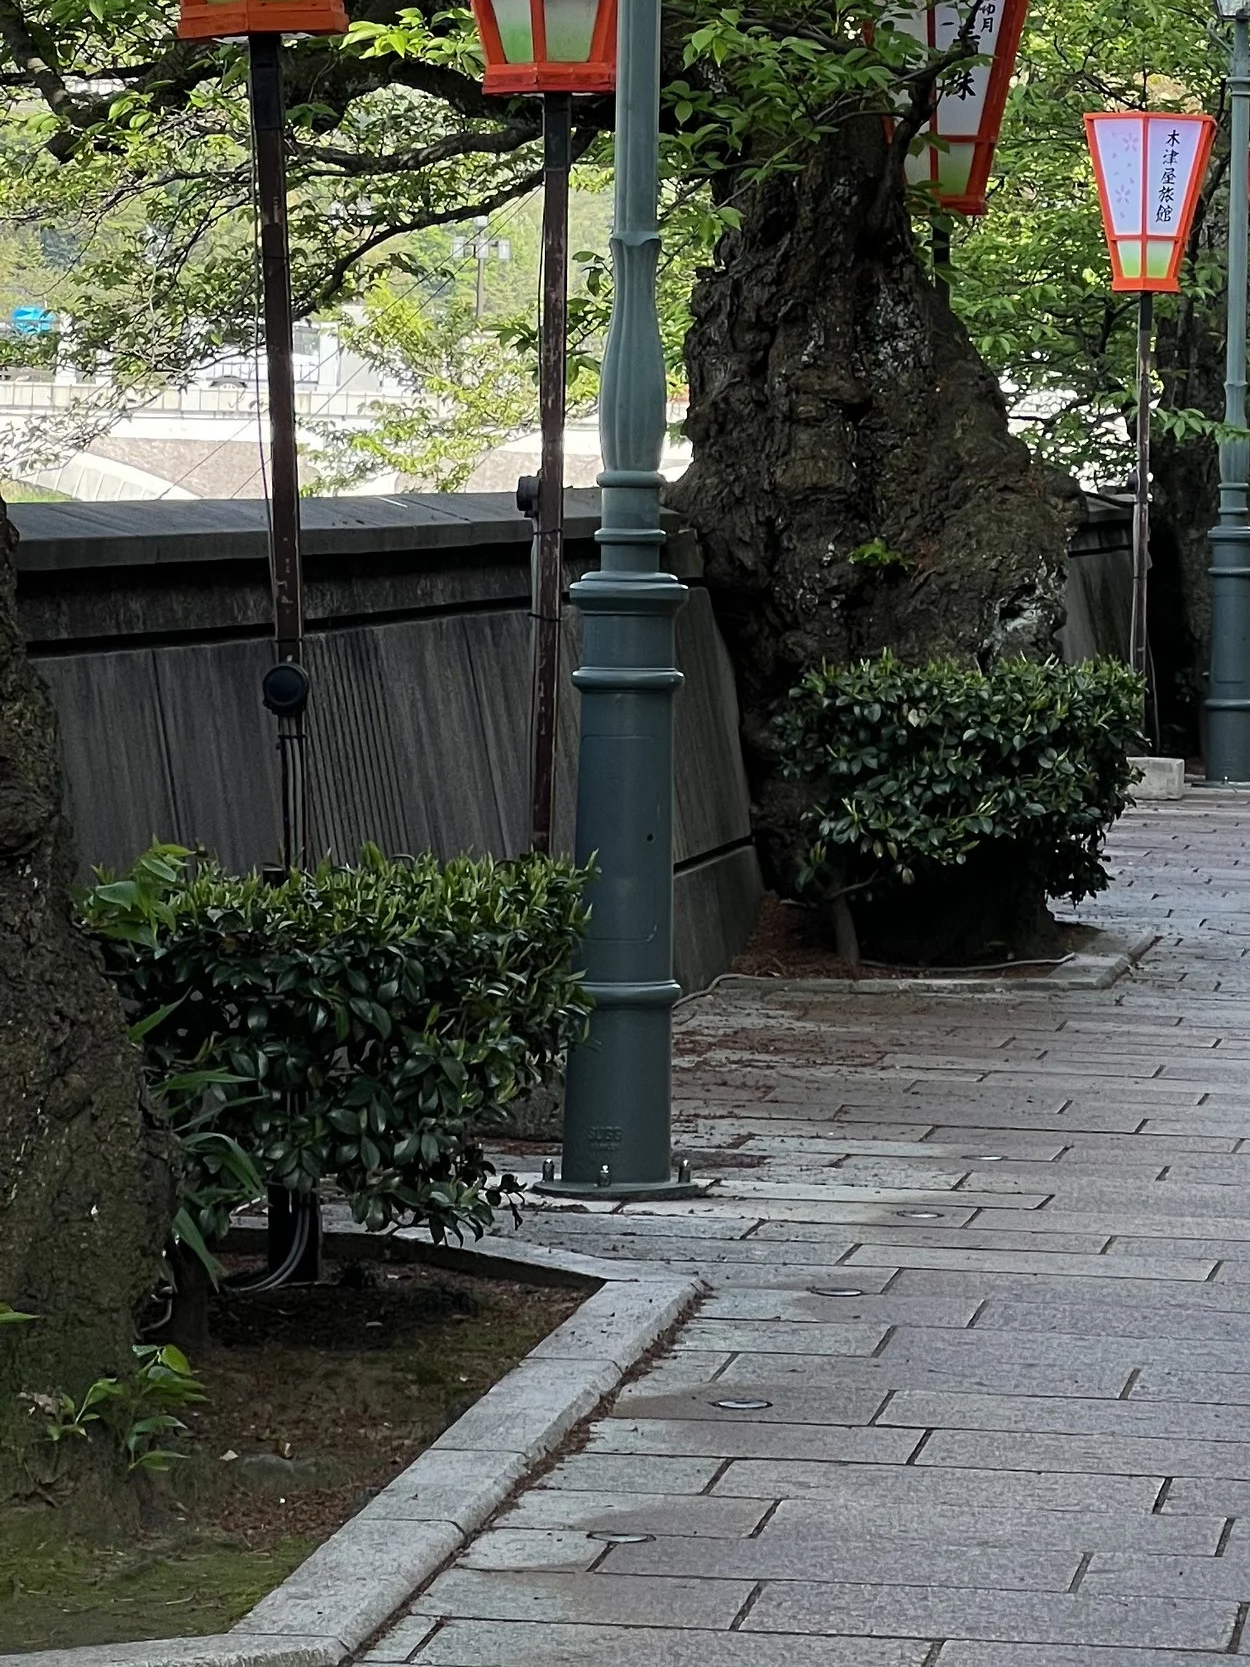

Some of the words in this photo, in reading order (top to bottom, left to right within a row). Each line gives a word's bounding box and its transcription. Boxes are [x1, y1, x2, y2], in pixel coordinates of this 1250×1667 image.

[1155, 129, 1180, 223] 木津屋旅館
